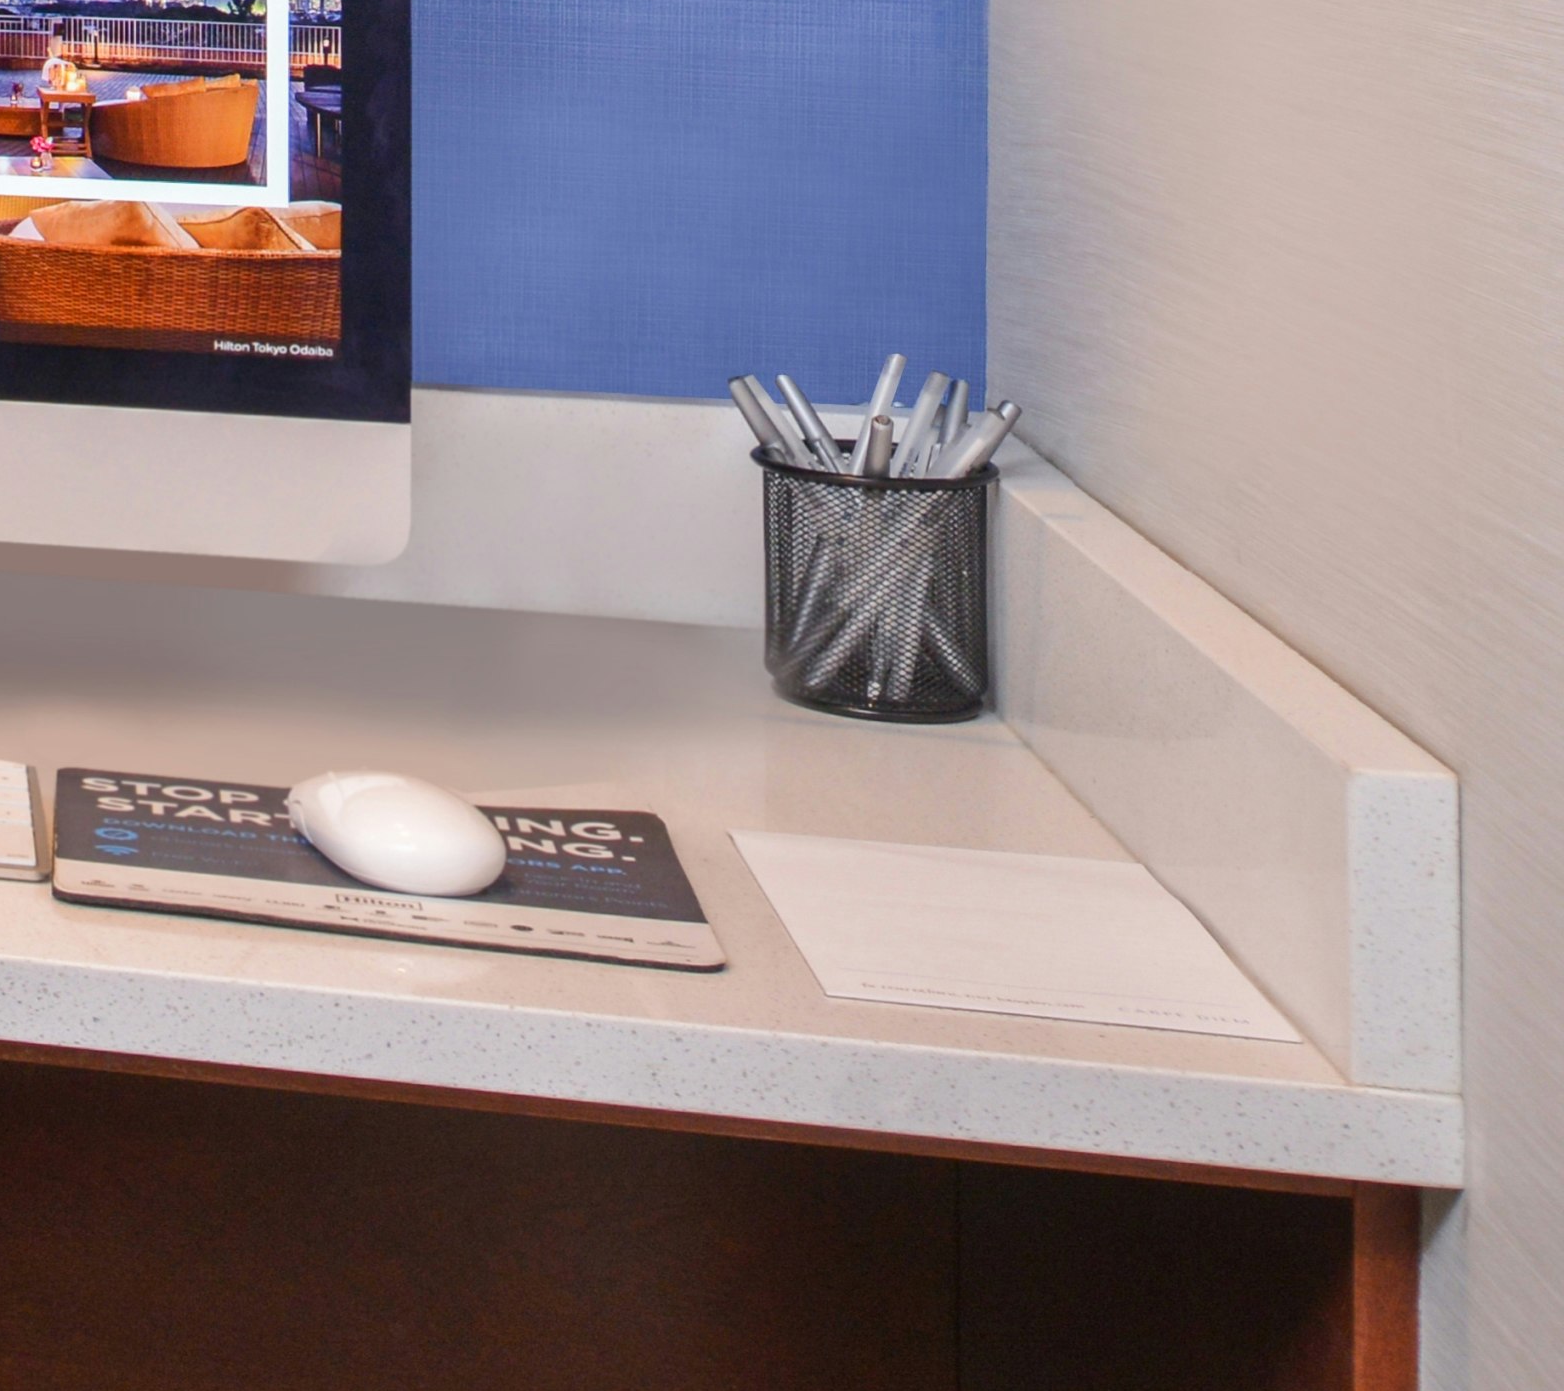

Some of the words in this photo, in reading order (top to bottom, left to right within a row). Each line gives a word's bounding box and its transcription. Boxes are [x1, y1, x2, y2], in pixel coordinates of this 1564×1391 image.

[213, 339, 250, 353] Hilton
[252, 341, 288, 356] Tokyo
[289, 344, 334, 358] Odaiba
[81, 776, 260, 805] STOP
